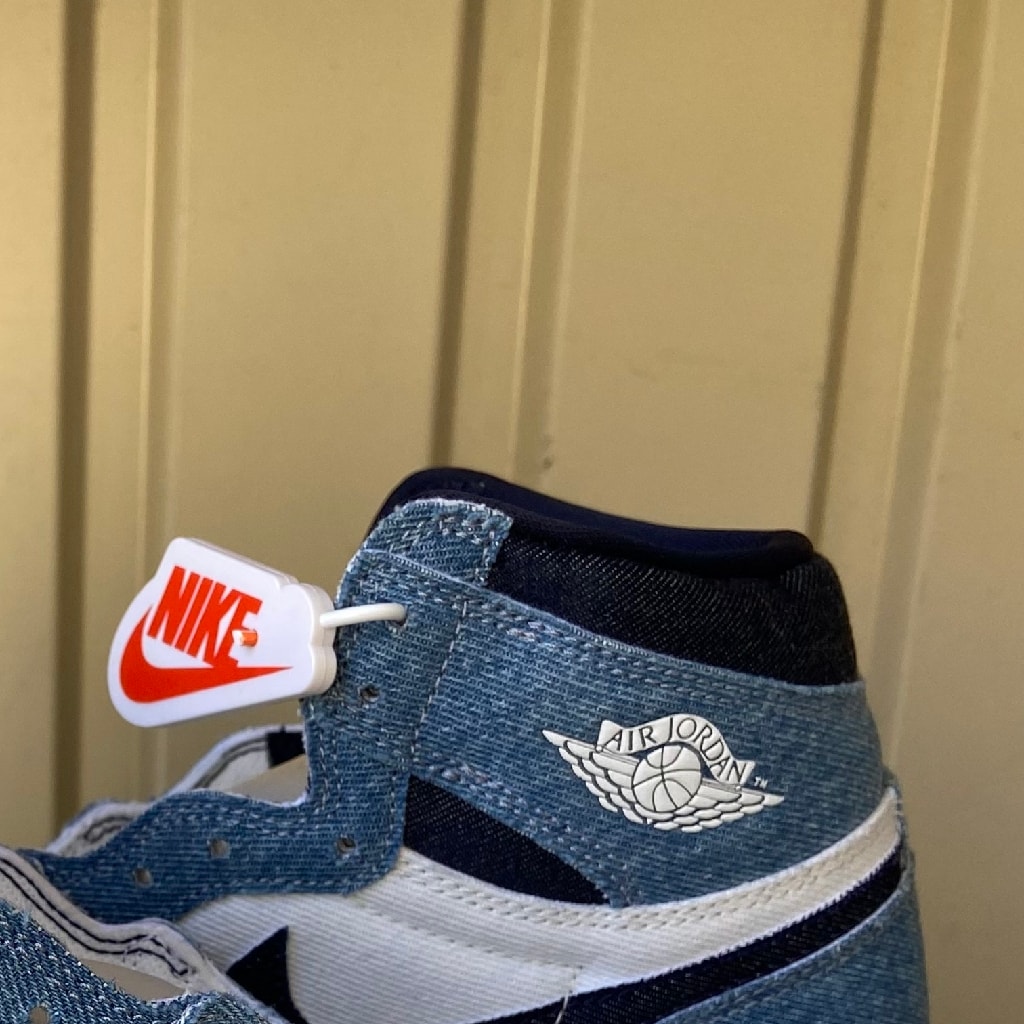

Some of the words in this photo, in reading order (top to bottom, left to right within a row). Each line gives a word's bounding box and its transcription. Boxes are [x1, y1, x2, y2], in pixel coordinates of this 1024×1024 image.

[148, 566, 263, 669] NIKE
[605, 726, 657, 751] AIR
[666, 717, 747, 785] JORDAN
